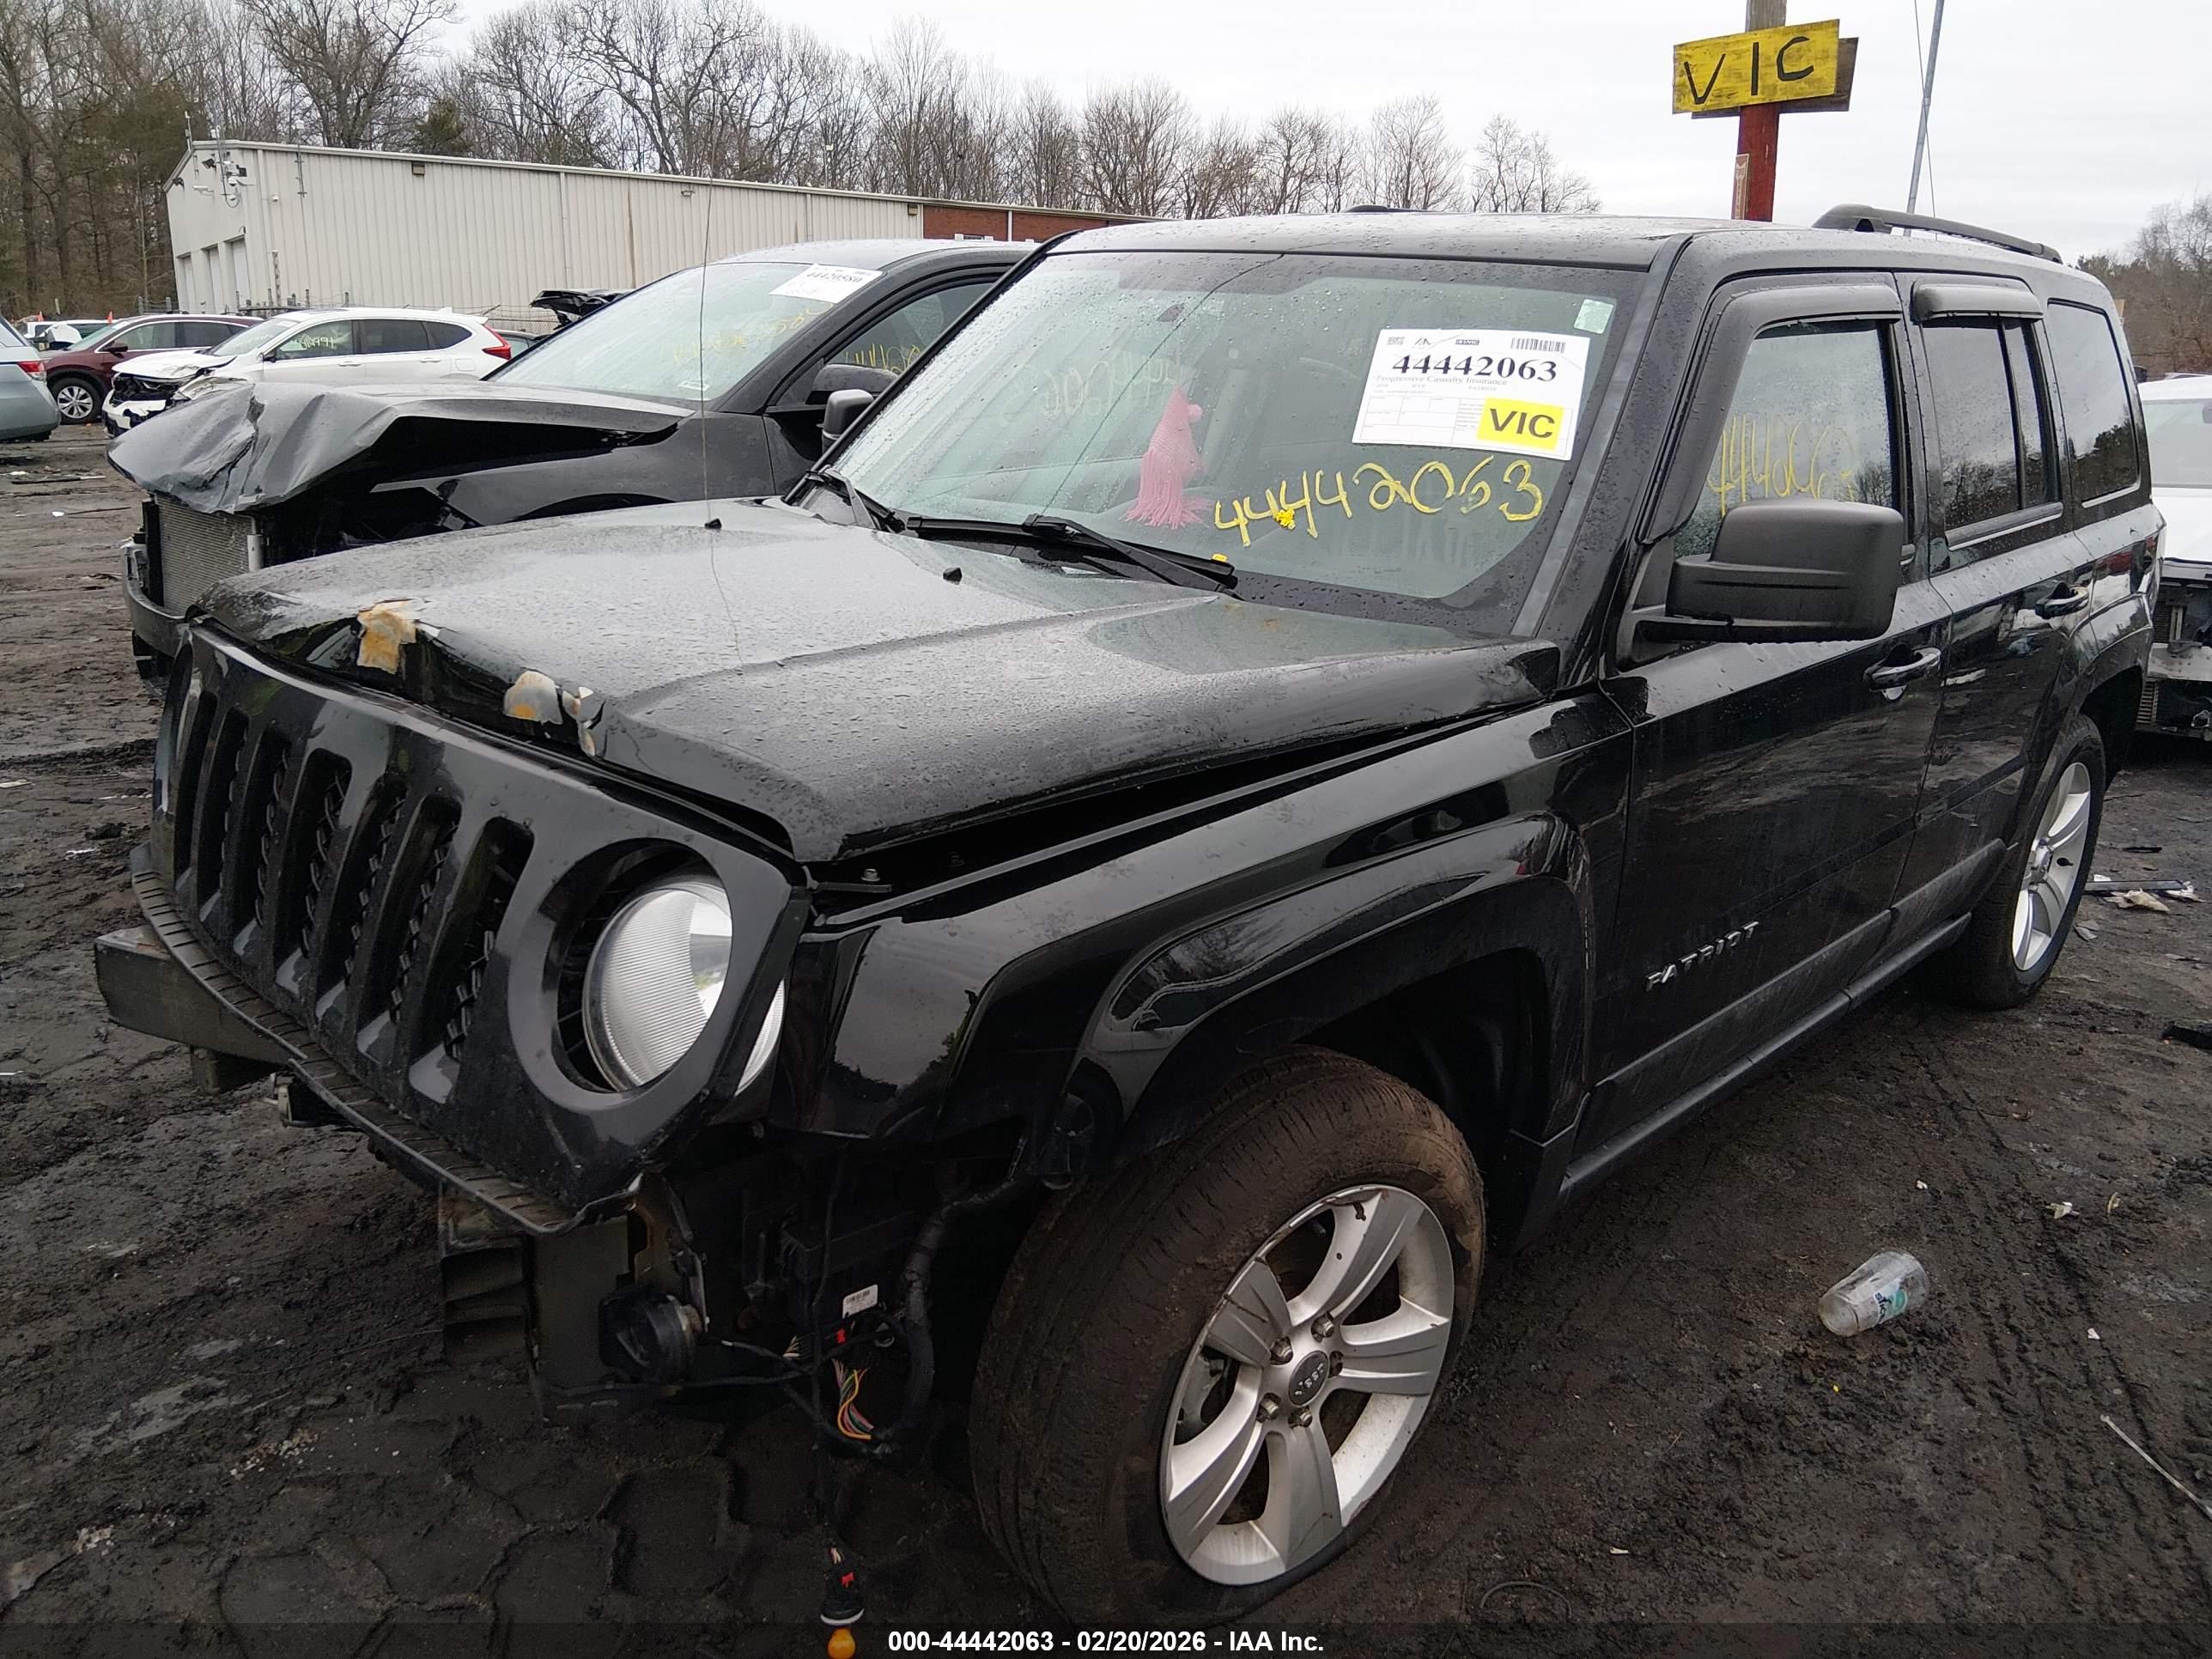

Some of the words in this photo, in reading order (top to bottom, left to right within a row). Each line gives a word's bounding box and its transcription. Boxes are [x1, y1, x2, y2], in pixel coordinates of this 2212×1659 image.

[1683, 35, 1814, 105] VIC
[1392, 354, 1558, 382] 44442063
[1426, 375, 1463, 385] Casualty
[1466, 377, 1508, 386] Insurance
[1489, 408, 1556, 439] VIC
[1214, 455, 1544, 548] 44442063
[1644, 921, 1759, 993] PATRIOT
